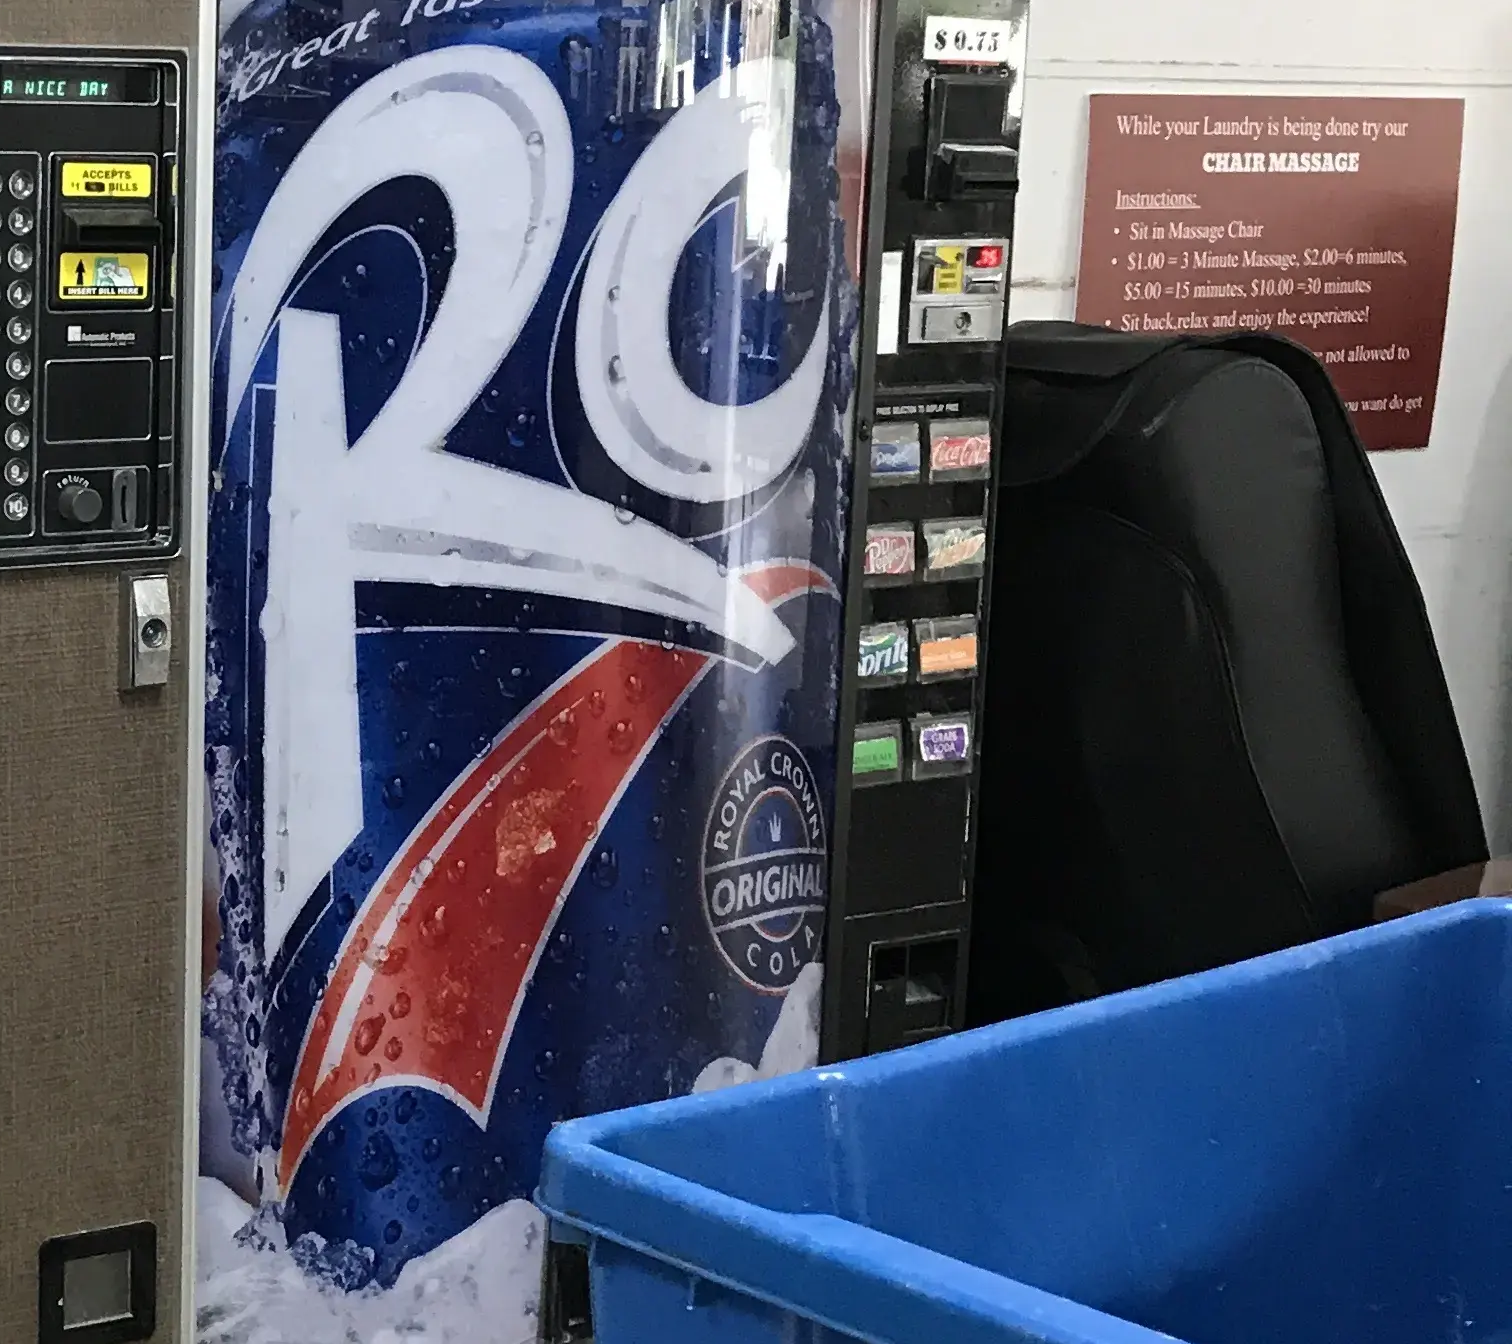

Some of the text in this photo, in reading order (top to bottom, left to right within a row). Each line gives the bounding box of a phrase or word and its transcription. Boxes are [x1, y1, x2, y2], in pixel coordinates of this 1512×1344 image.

[934, 29, 1001, 52] $ 0.75
[234, 6, 381, 105] Great
[3, 79, 109, 97] A NICE DAY
[1116, 115, 1408, 141] While your Laundry is being done try our
[1202, 152, 1360, 173] CHAIR MASSAGE
[82, 170, 132, 179] ACCEPTS
[109, 183, 138, 191] BILLS
[1115, 189, 1198, 209] Instructions:
[1129, 220, 1264, 244] Sit in Massage Chair
[1127, 252, 1164, 271] $1.00
[1180, 252, 1189, 270] 3
[1192, 251, 1239, 270] Minute
[1242, 249, 1300, 271] Massage,
[1123, 282, 1162, 302] $5.00
[1193, 280, 1247, 298] minutes,
[1250, 278, 1294, 298] $10.00
[1324, 277, 1372, 294] minutes
[1120, 312, 1139, 332] Sit
[1212, 310, 1236, 328] and
[1239, 311, 1273, 332] enjoy
[1277, 308, 1296, 326] the
[1299, 306, 1370, 328] experience!
[1325, 344, 1410, 363] not allowed to
[56, 474, 91, 489] return
[714, 752, 820, 851] ROYAL CROWN
[712, 863, 823, 917] ORIGINAL
[747, 925, 815, 975] COLA
